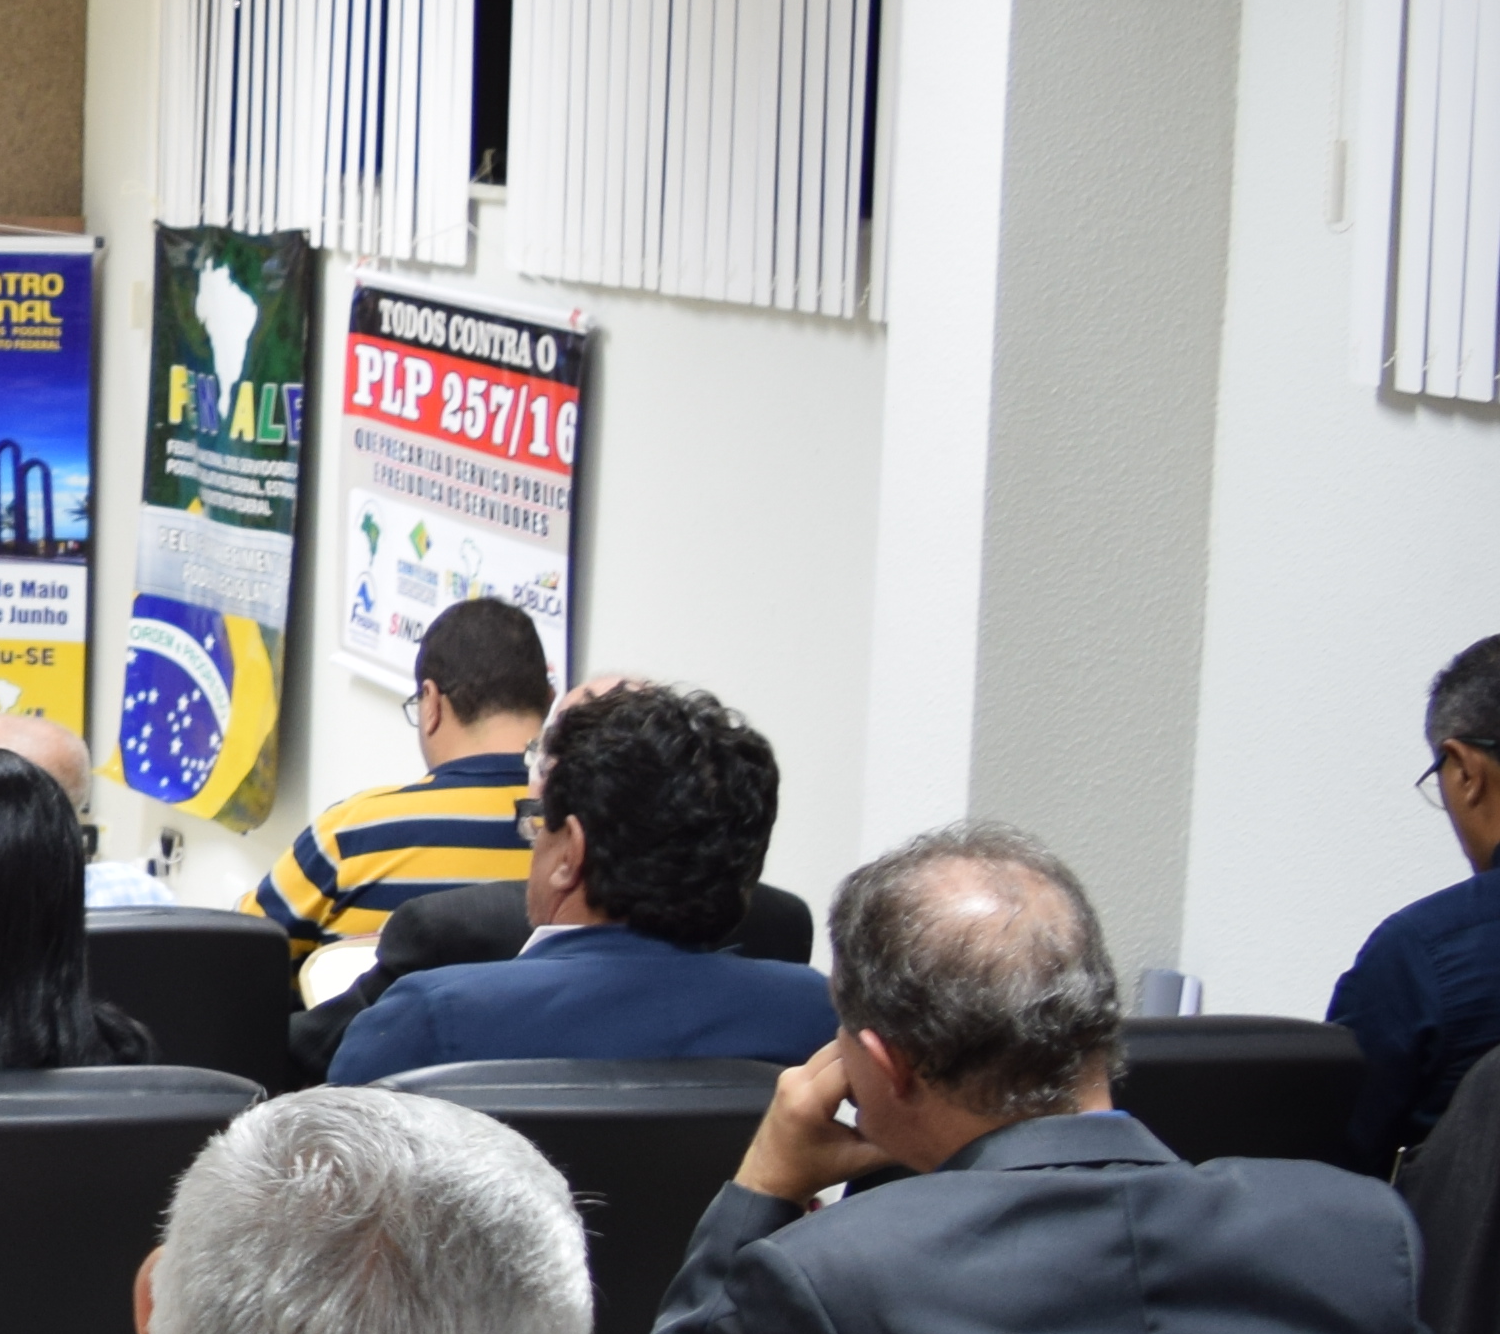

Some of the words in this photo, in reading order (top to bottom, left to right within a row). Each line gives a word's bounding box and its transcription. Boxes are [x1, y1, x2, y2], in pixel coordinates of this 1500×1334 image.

[378, 298, 447, 347] TODOS
[449, 314, 533, 368] CONTRA
[536, 334, 558, 373] O
[352, 343, 433, 421] PLP
[440, 371, 577, 465] 257/16
[354, 427, 378, 453] QUE
[379, 434, 443, 473] PRECARIZA
[444, 455, 453, 477] O
[380, 464, 444, 502] PREJUDICA
[446, 484, 463, 509] OS
[464, 490, 550, 537] SERVIDORES
[20, 581, 69, 599] Maio
[9, 606, 69, 626] Junho
[130, 625, 175, 647] ORDEM
